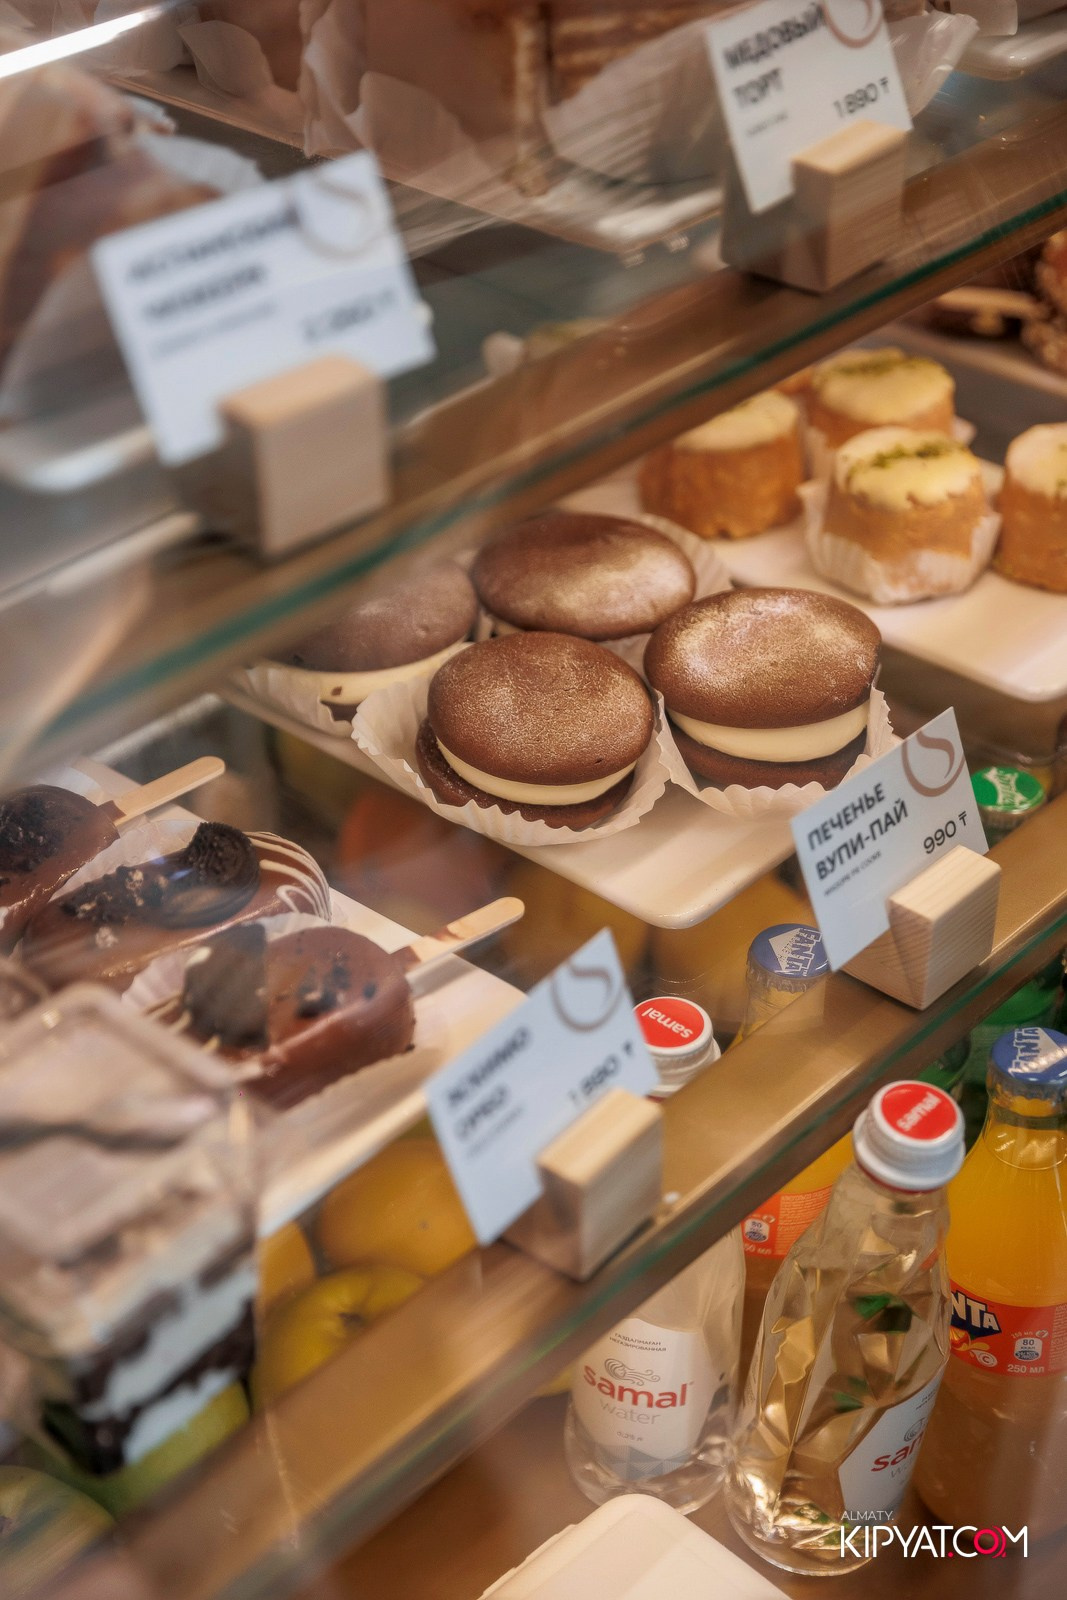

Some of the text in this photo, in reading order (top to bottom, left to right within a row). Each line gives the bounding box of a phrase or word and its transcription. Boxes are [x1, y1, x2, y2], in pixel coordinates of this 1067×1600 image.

[722, 2, 824, 69] МЕДОВЫЙ
[807, 782, 886, 851] ПЕЧЕНЬЕ
[923, 820, 957, 854] 990
[815, 798, 909, 881] ВУПИ-ПАЙ
[784, 928, 822, 972] FANTA
[641, 1007, 693, 1039] samal
[896, 1090, 942, 1132] samal
[950, 1290, 1000, 1331] NTA
[583, 1365, 688, 1409] samal
[1007, 1363, 1027, 1373] 250
[601, 1401, 661, 1425] water
